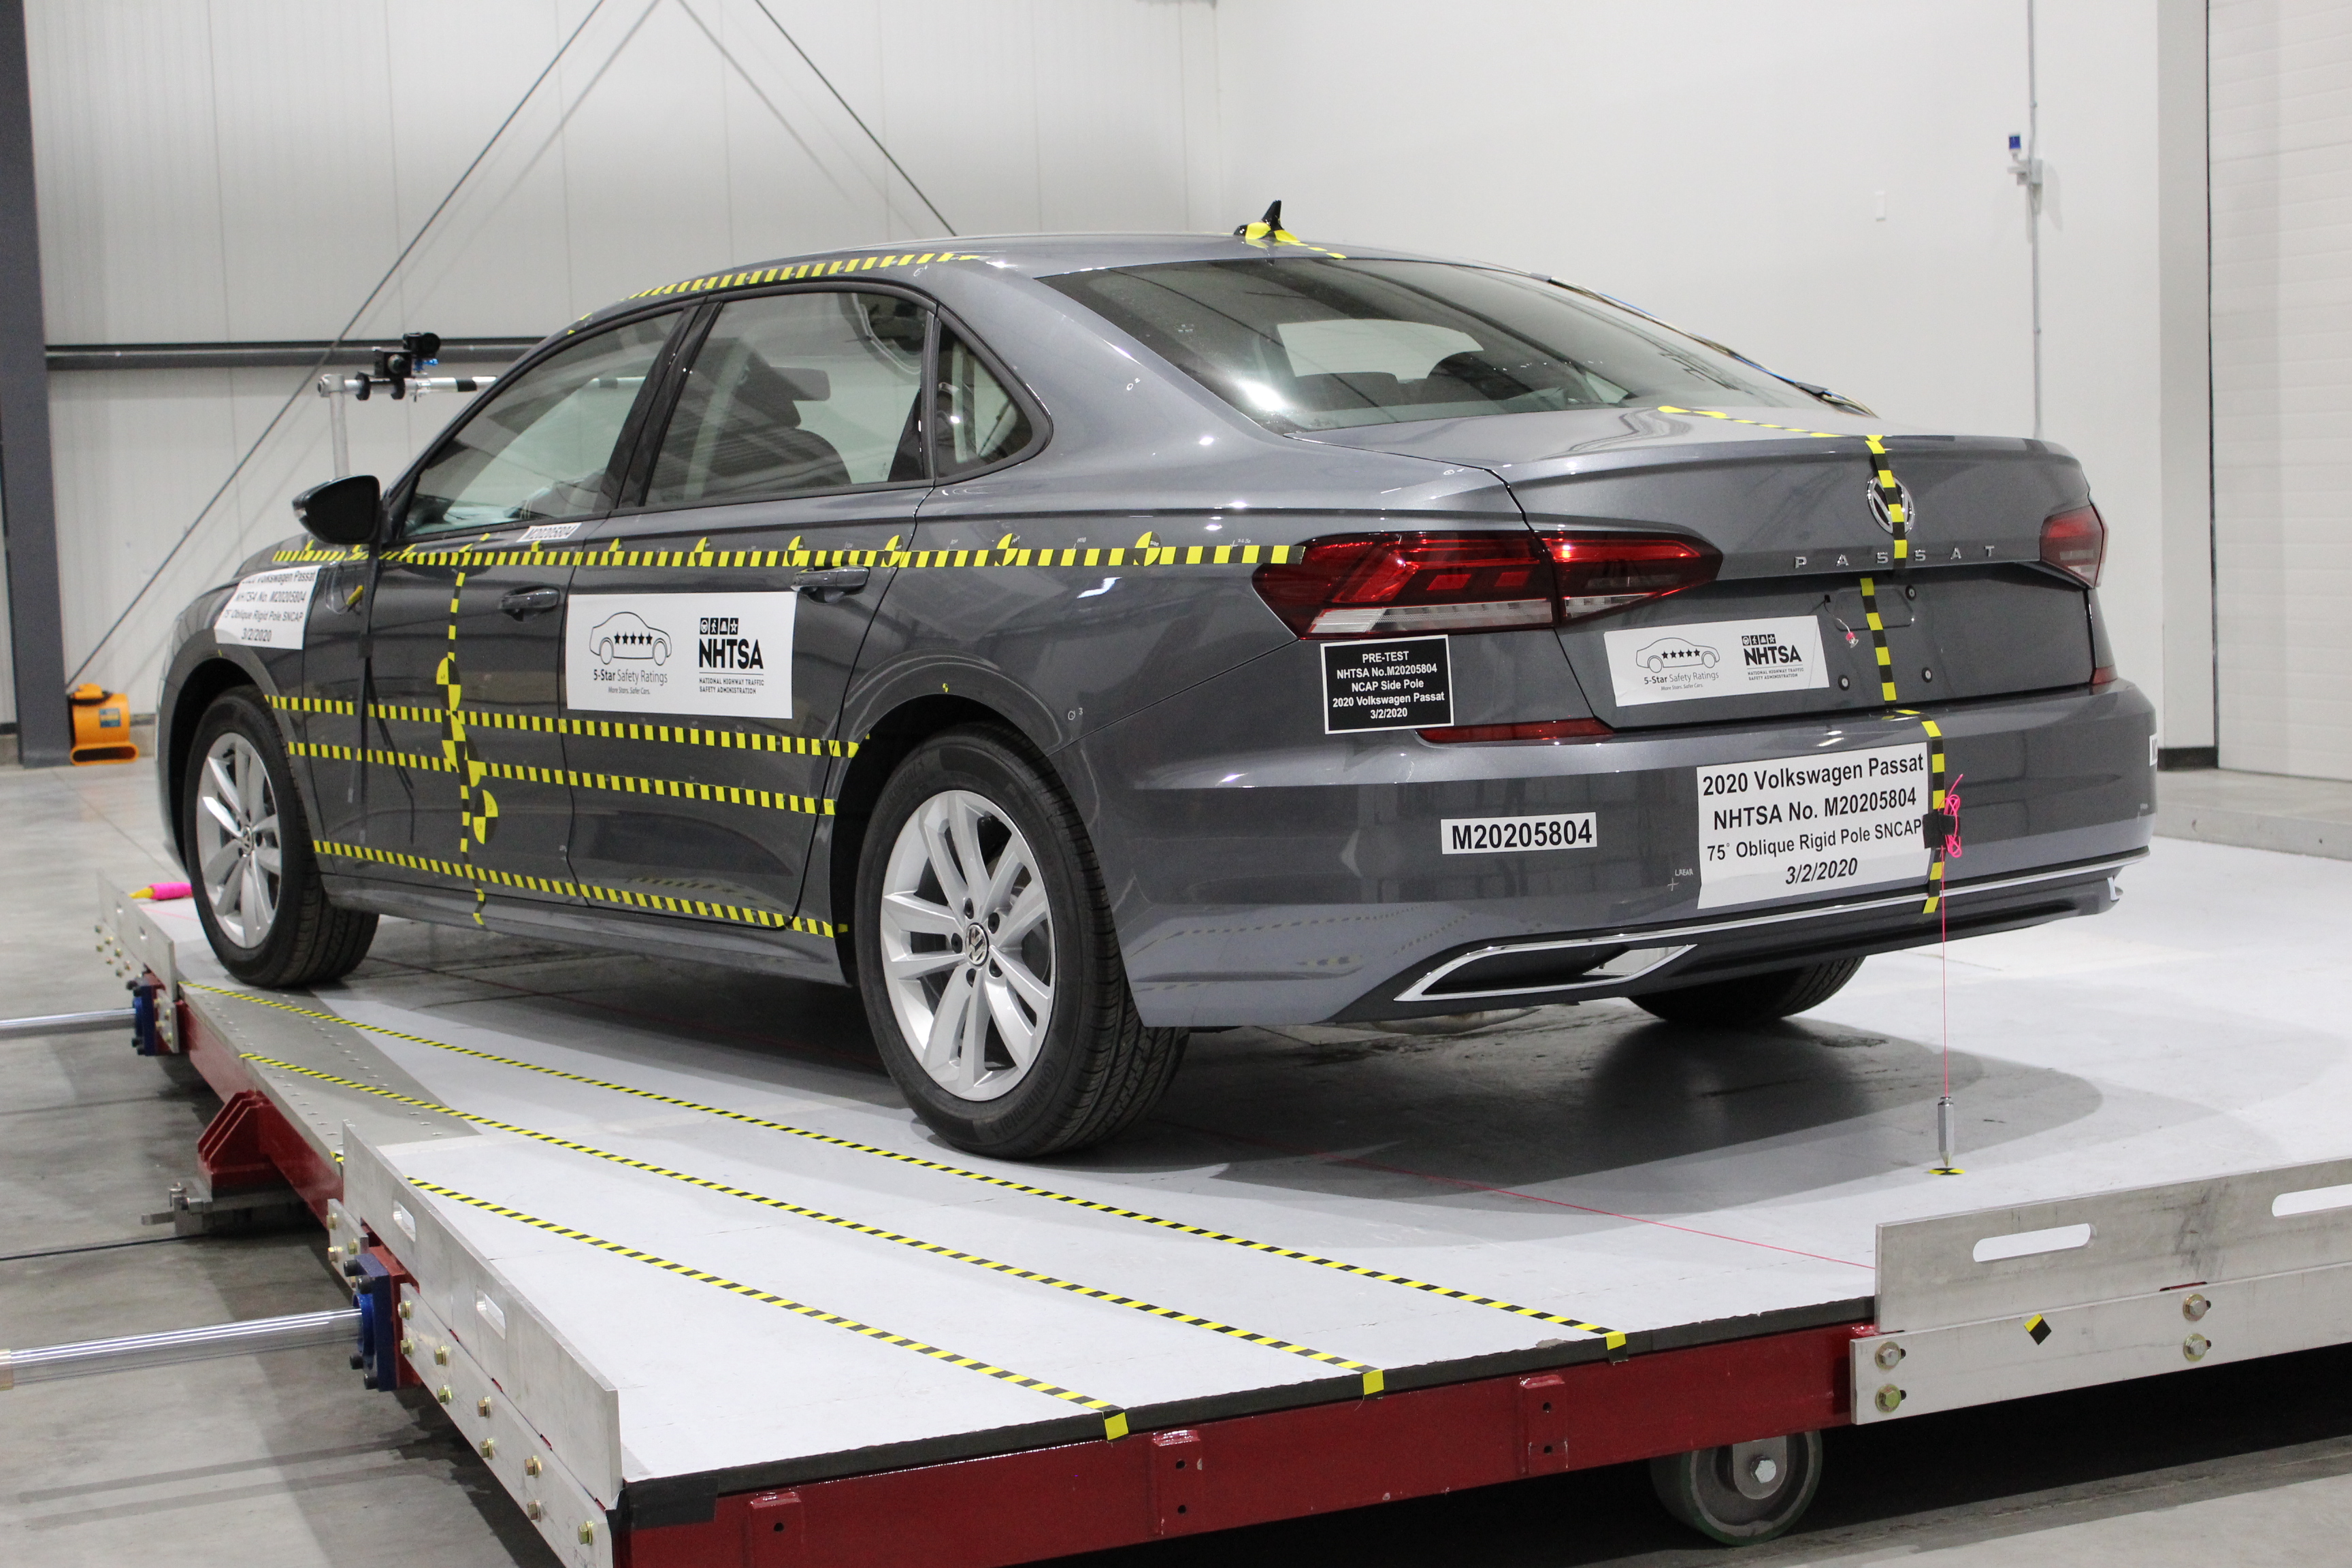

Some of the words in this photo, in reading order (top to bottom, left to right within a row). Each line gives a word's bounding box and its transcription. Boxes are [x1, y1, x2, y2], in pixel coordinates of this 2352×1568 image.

[1795, 545, 1995, 569] PASSAT
[282, 611, 304, 622] SNCAP
[241, 627, 272, 642] 3/2/2020
[699, 638, 764, 669] NHTSA
[1362, 651, 1409, 663] PRE-TEST
[1744, 644, 1802, 666] NHTSA
[593, 668, 616, 681] 5-Star
[617, 668, 639, 685] Safety
[641, 670, 668, 686] Ratings
[1337, 668, 1369, 679] NHTSA
[1372, 663, 1437, 678] No.M20205804
[1644, 676, 1667, 685] 5-Star
[1669, 673, 1691, 683] Safety
[1693, 671, 1719, 681] Ratings
[1352, 681, 1378, 692] NCAP
[1381, 679, 1401, 691] Side
[1404, 679, 1424, 689] Pole
[1333, 697, 1354, 708] 2020
[1356, 694, 1411, 706] Volkswagen
[1414, 691, 1445, 702] Passat
[1370, 708, 1407, 719] 3/2/2020
[1703, 772, 1748, 796] 2020
[1754, 763, 1863, 790] Volkswagen
[1868, 753, 1924, 776] Passat
[1714, 804, 1782, 830] NHTSA
[1788, 801, 1818, 821] No.
[1825, 787, 1916, 817] M20205804
[1452, 819, 1592, 849] M20205804
[1736, 836, 1795, 858] Oblique
[1799, 830, 1836, 853] Rigid
[1841, 824, 1870, 843] Pole
[1875, 818, 1922, 840] SNCAP
[1675, 868, 1693, 877] LREAR
[1785, 857, 1858, 885] 3/2/2020
